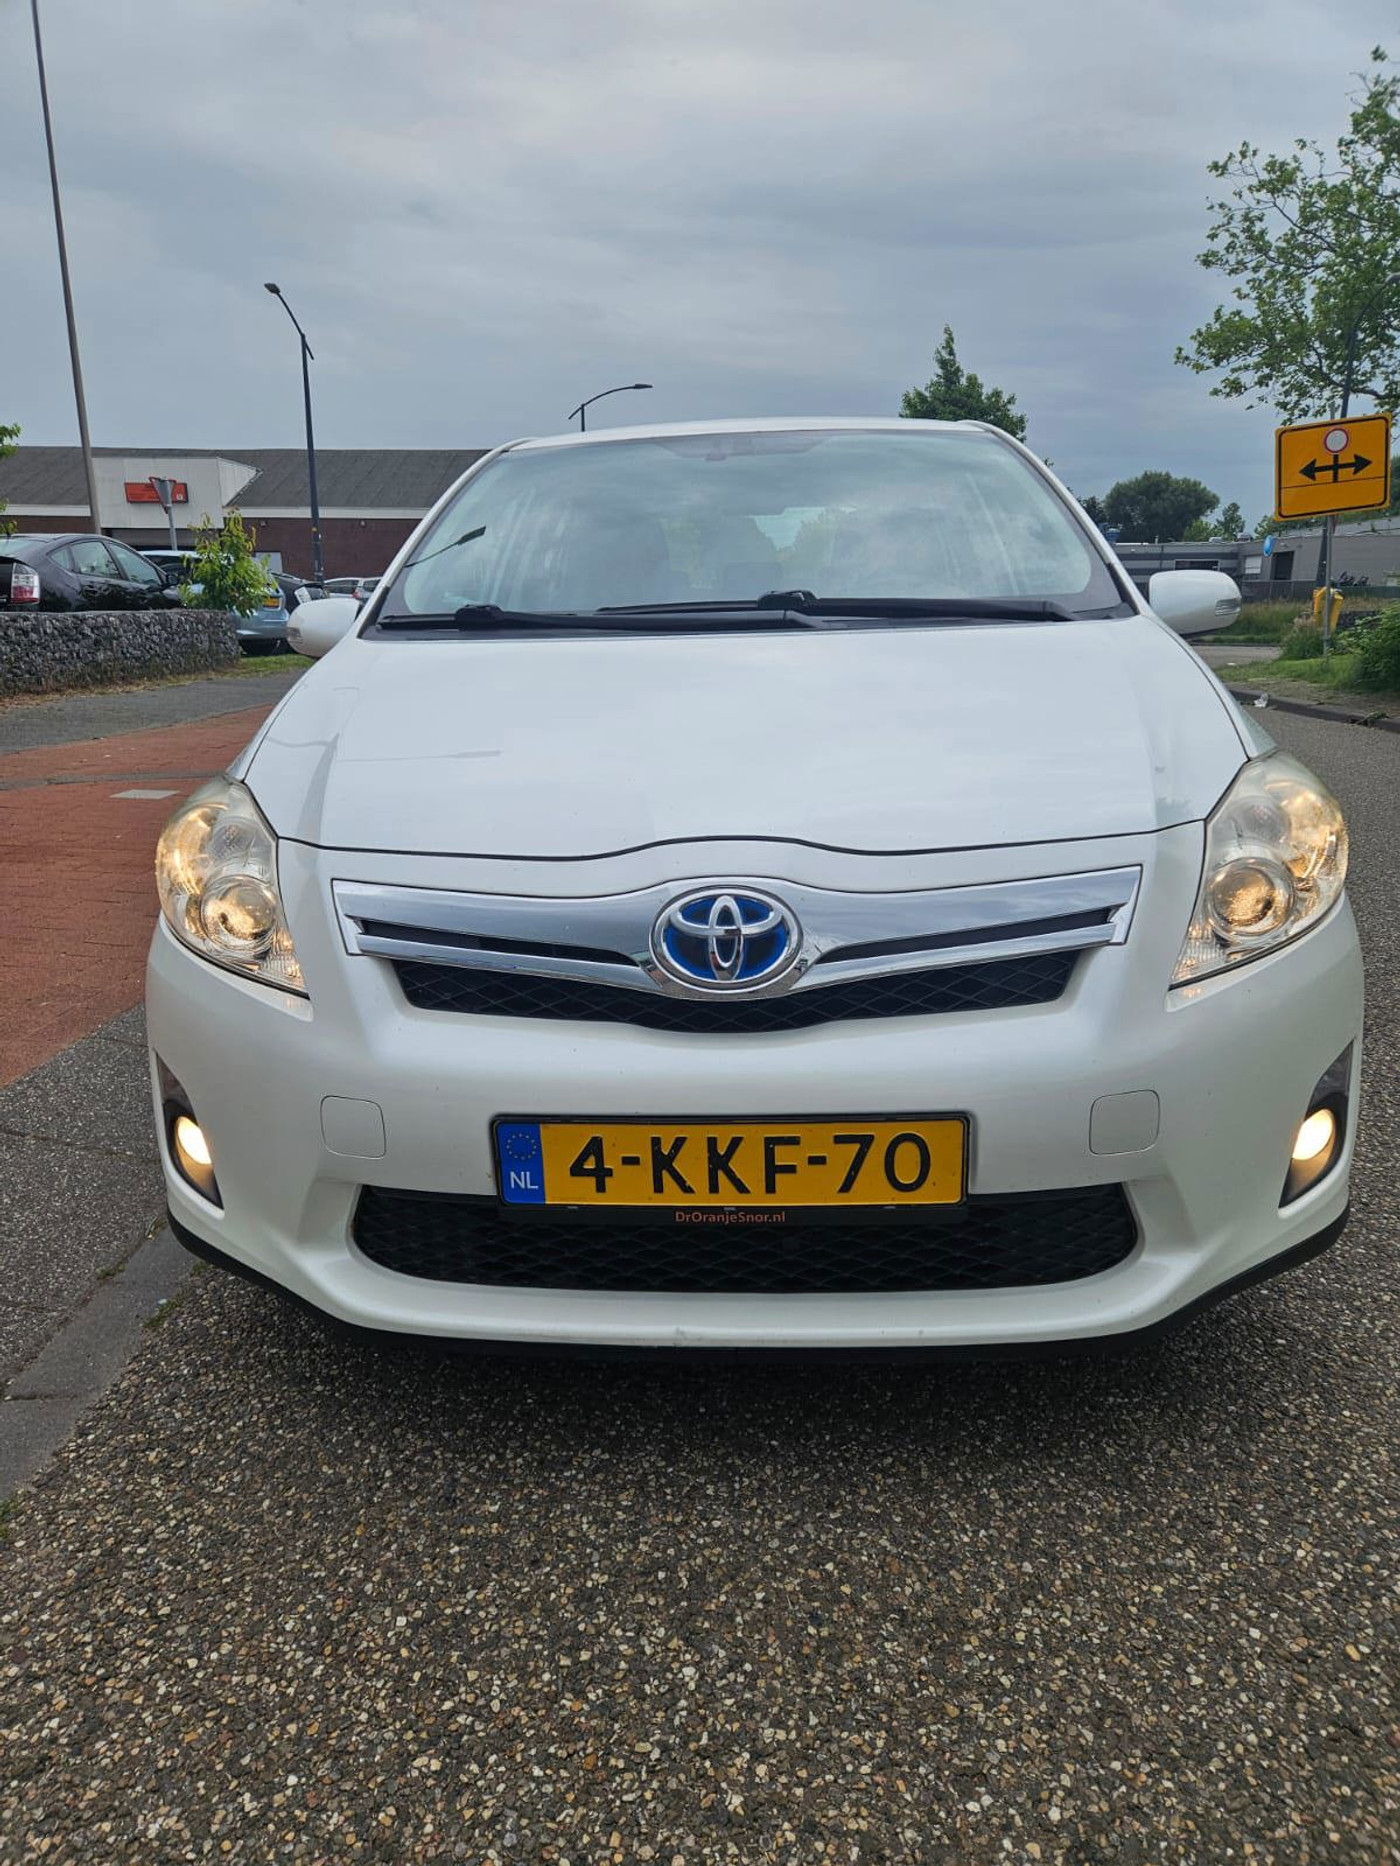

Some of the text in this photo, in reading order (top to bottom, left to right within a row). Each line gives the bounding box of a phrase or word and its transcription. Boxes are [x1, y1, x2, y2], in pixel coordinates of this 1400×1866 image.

[569, 1132, 932, 1195] 4-KKF-70
[510, 1171, 539, 1190] NL
[675, 1211, 786, 1225] DrOranjeSnor.nl
